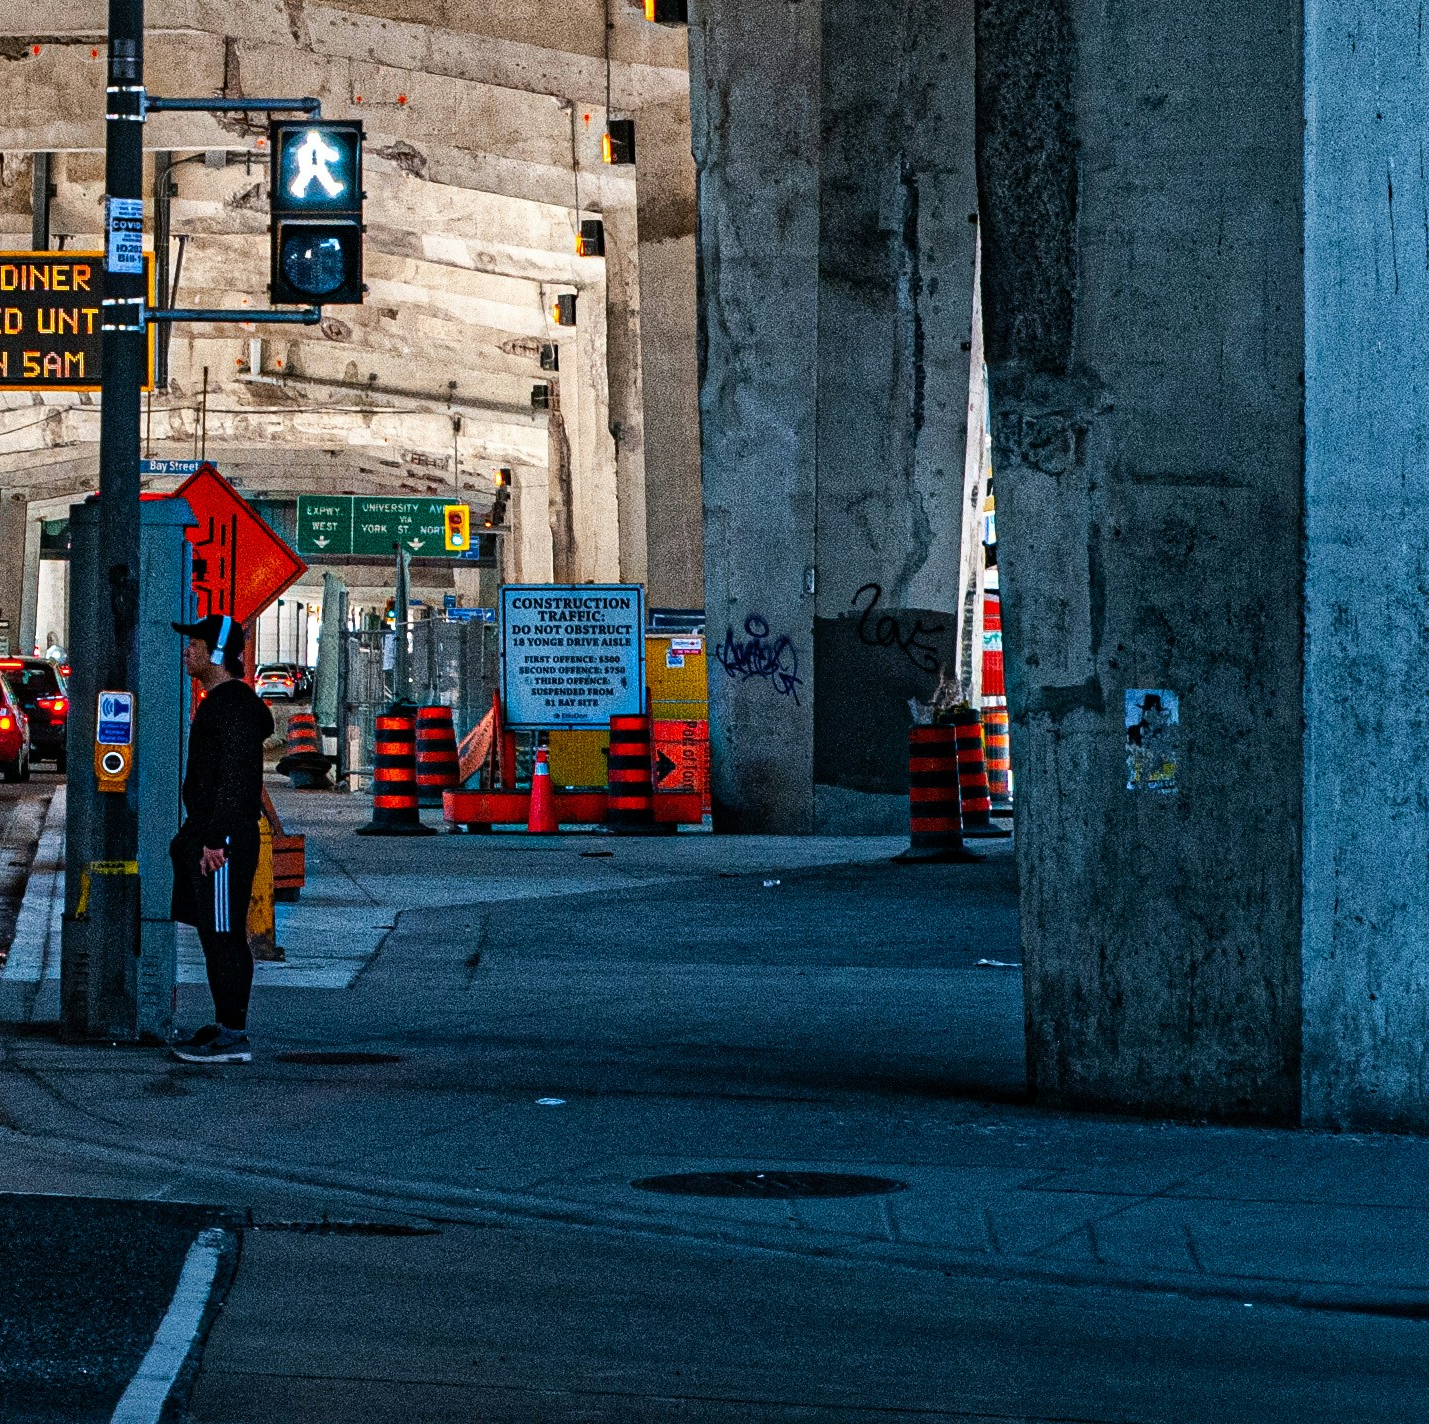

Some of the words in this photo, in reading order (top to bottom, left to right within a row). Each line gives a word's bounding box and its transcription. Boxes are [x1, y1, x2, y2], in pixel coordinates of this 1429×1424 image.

[37, 307, 100, 335] UNT
[23, 351, 85, 378] 5AM
[150, 461, 167, 473] Bay
[169, 461, 199, 471] Street
[362, 503, 419, 513] UNIVERSITY
[429, 504, 445, 514] AV
[312, 522, 338, 531] WEST
[362, 524, 387, 533] YORK
[420, 526, 445, 534] NORT
[512, 598, 630, 609] CONSTRUCTION
[538, 611, 605, 622] TRAFFIC:
[512, 625, 531, 635] DO
[534, 625, 562, 635] NOT
[565, 625, 632, 635] OBSTRUCT
[513, 638, 524, 647] 18
[527, 638, 564, 647] YONGE
[566, 638, 599, 647] DRIVE
[602, 638, 631, 647] AISLE
[524, 655, 550, 663] FIRST
[552, 655, 597, 663] OFFENCE:
[599, 655, 620, 663] $500
[519, 666, 556, 674] SECOND
[558, 666, 602, 674] OFFENCE:
[604, 666, 625, 674] $750
[534, 677, 564, 685] THIRD
[531, 688, 585, 696] SUSPENDED
[587, 688, 614, 696] FROM
[558, 699, 576, 707] BAY
[578, 699, 599, 707] SITE
